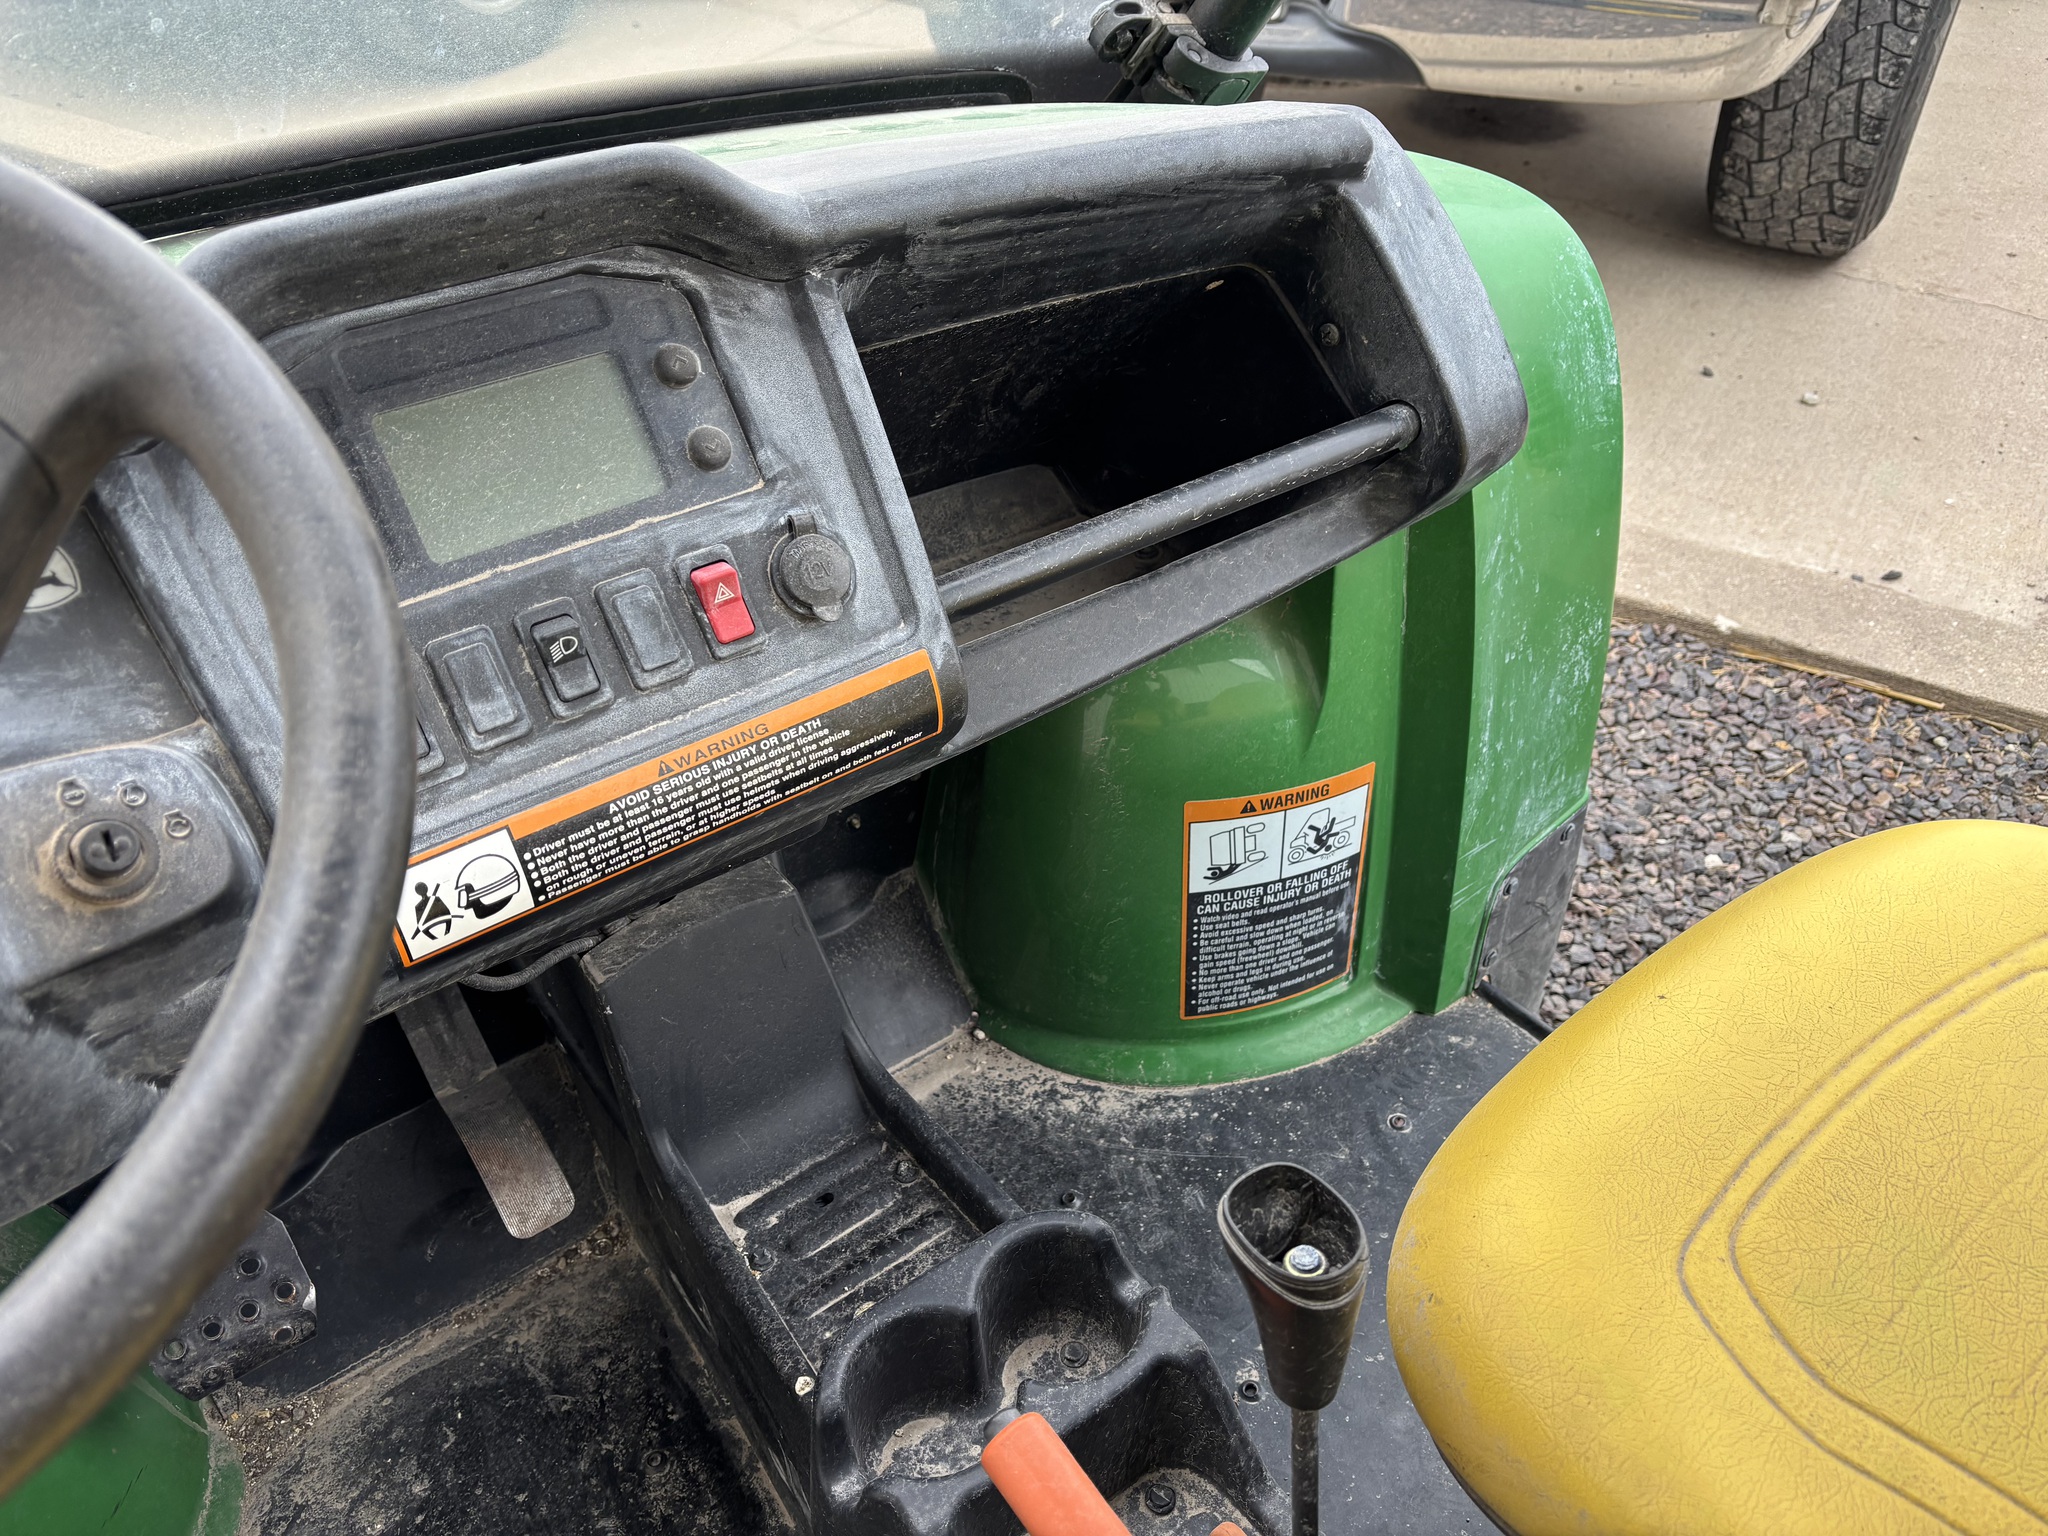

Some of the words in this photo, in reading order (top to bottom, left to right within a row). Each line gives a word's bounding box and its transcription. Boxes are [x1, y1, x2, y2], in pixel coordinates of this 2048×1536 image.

[673, 723, 770, 770] WARNING
[607, 788, 651, 814] AVOID
[652, 763, 711, 796] SERIOUS
[712, 744, 758, 771] INJURY
[760, 735, 779, 751] OR
[781, 717, 822, 743] DEATH
[532, 836, 567, 857] Driver
[567, 825, 596, 843] must
[596, 818, 611, 830] be
[611, 813, 623, 824] at
[624, 801, 650, 818] least
[651, 795, 665, 807] 16
[666, 784, 694, 802] years
[694, 776, 712, 789] old
[712, 766, 734, 782] with
[735, 764, 742, 772] a
[743, 752, 767, 769] valid
[768, 740, 795, 758] driver
[797, 726, 829, 746] license
[536, 847, 569, 867] Never
[570, 836, 596, 853] have
[597, 824, 625, 841] more
[626, 813, 650, 829] than
[651, 804, 670, 818] the
[669, 791, 700, 810] driver
[700, 783, 720, 797] and
[721, 776, 740, 789] one
[741, 754, 790, 781] passenger
[791, 749, 801, 759] in
[802, 742, 817, 754] the
[818, 728, 851, 747] vehicle
[543, 868, 569, 884] Both
[570, 859, 589, 873] the
[589, 845, 621, 864] driver
[622, 836, 643, 850] and
[644, 814, 697, 842] passenger
[697, 802, 722, 818] must
[724, 794, 742, 807] use
[743, 777, 780, 799] helmets
[781, 766, 806, 782] when
[808, 752, 839, 772] driving
[840, 727, 896, 758] aggressively,
[1260, 784, 1330, 811] WARNING
[539, 859, 567, 876] Both
[567, 851, 586, 864] the
[587, 836, 619, 856] driver
[619, 827, 640, 842] and
[641, 805, 695, 834] passenger
[695, 793, 721, 810] must
[722, 786, 740, 798] use
[741, 766, 784, 790] seatbelts
[784, 761, 795, 771] at
[796, 756, 808, 767] all
[808, 745, 833, 761] times
[547, 871, 603, 900] Passenger
[604, 858, 631, 874] must
[632, 852, 645, 862] be
[646, 842, 669, 856] able
[670, 836, 681, 845] to
[682, 825, 711, 841] grasp
[712, 801, 762, 828] handholds
[763, 792, 783, 805] with
[784, 776, 820, 796] seatbelt
[821, 771, 833, 780] on
[834, 762, 851, 774] and
[852, 753, 872, 766] both
[874, 745, 890, 757] feet
[891, 741, 902, 749] on
[903, 731, 923, 744] floor
[545, 882, 560, 892] on
[561, 866, 594, 886] rough
[595, 861, 608, 871] or
[609, 844, 646, 864] uneven
[648, 828, 684, 849] terrain,
[685, 822, 697, 831] or
[698, 817, 708, 826] at
[710, 803, 741, 822] higher
[742, 788, 776, 808] speeds
[1197, 904, 1220, 915] CAN
[1223, 896, 1260, 912] CAUSE
[1263, 886, 1301, 905] INJURY
[1304, 881, 1319, 894] OR
[1322, 868, 1352, 888] DEATH
[1204, 886, 1263, 905] ROLLOVER
[1267, 881, 1282, 894] OR
[1285, 868, 1327, 890] FALLING
[1330, 860, 1348, 875] OFF
[1200, 915, 1220, 923] Watch
[1222, 913, 1239, 921] video
[1240, 910, 1252, 918] and
[1254, 907, 1268, 916] read
[1200, 931, 1219, 939] Avoid
[1221, 925, 1253, 937] excessive
[1255, 920, 1275, 932] speed
[1276, 917, 1288, 926] and
[1289, 911, 1306, 923] sharp
[1215, 922, 1230, 930] seat
[1199, 945, 1225, 954] difficult
[1254, 932, 1284, 946] operating
[1293, 925, 1308, 936] night
[1210, 936, 1234, 945] careful
[1235, 933, 1248, 942] and
[1250, 930, 1266, 939] slow
[1267, 925, 1283, 935] down
[1285, 920, 1301, 930] when
[1214, 950, 1236, 960] brakes
[1238, 946, 1256, 957] going
[1258, 942, 1275, 952] down
[1302, 926, 1324, 939] Vehicle
[1325, 922, 1335, 931] can
[1199, 976, 1216, 984] Keep
[1217, 973, 1234, 981] arms
[1236, 970, 1248, 978] and
[1250, 966, 1263, 976] legs
[1272, 958, 1291, 970] during
[1215, 958, 1235, 968] speed
[1229, 964, 1243, 972] than
[1258, 956, 1277, 966] driver
[1278, 952, 1290, 961] and
[1291, 949, 1302, 957] one
[1198, 982, 1218, 991] Never
[1220, 978, 1245, 989] operate
[1246, 972, 1269, 983] vehicle
[1271, 967, 1288, 977] under
[1198, 989, 1223, 998] alcohol
[1211, 993, 1236, 1004] off-road
[1280, 975, 1305, 988] intended
[1198, 1004, 1218, 1013] public
[1220, 1000, 1238, 1010] roads
